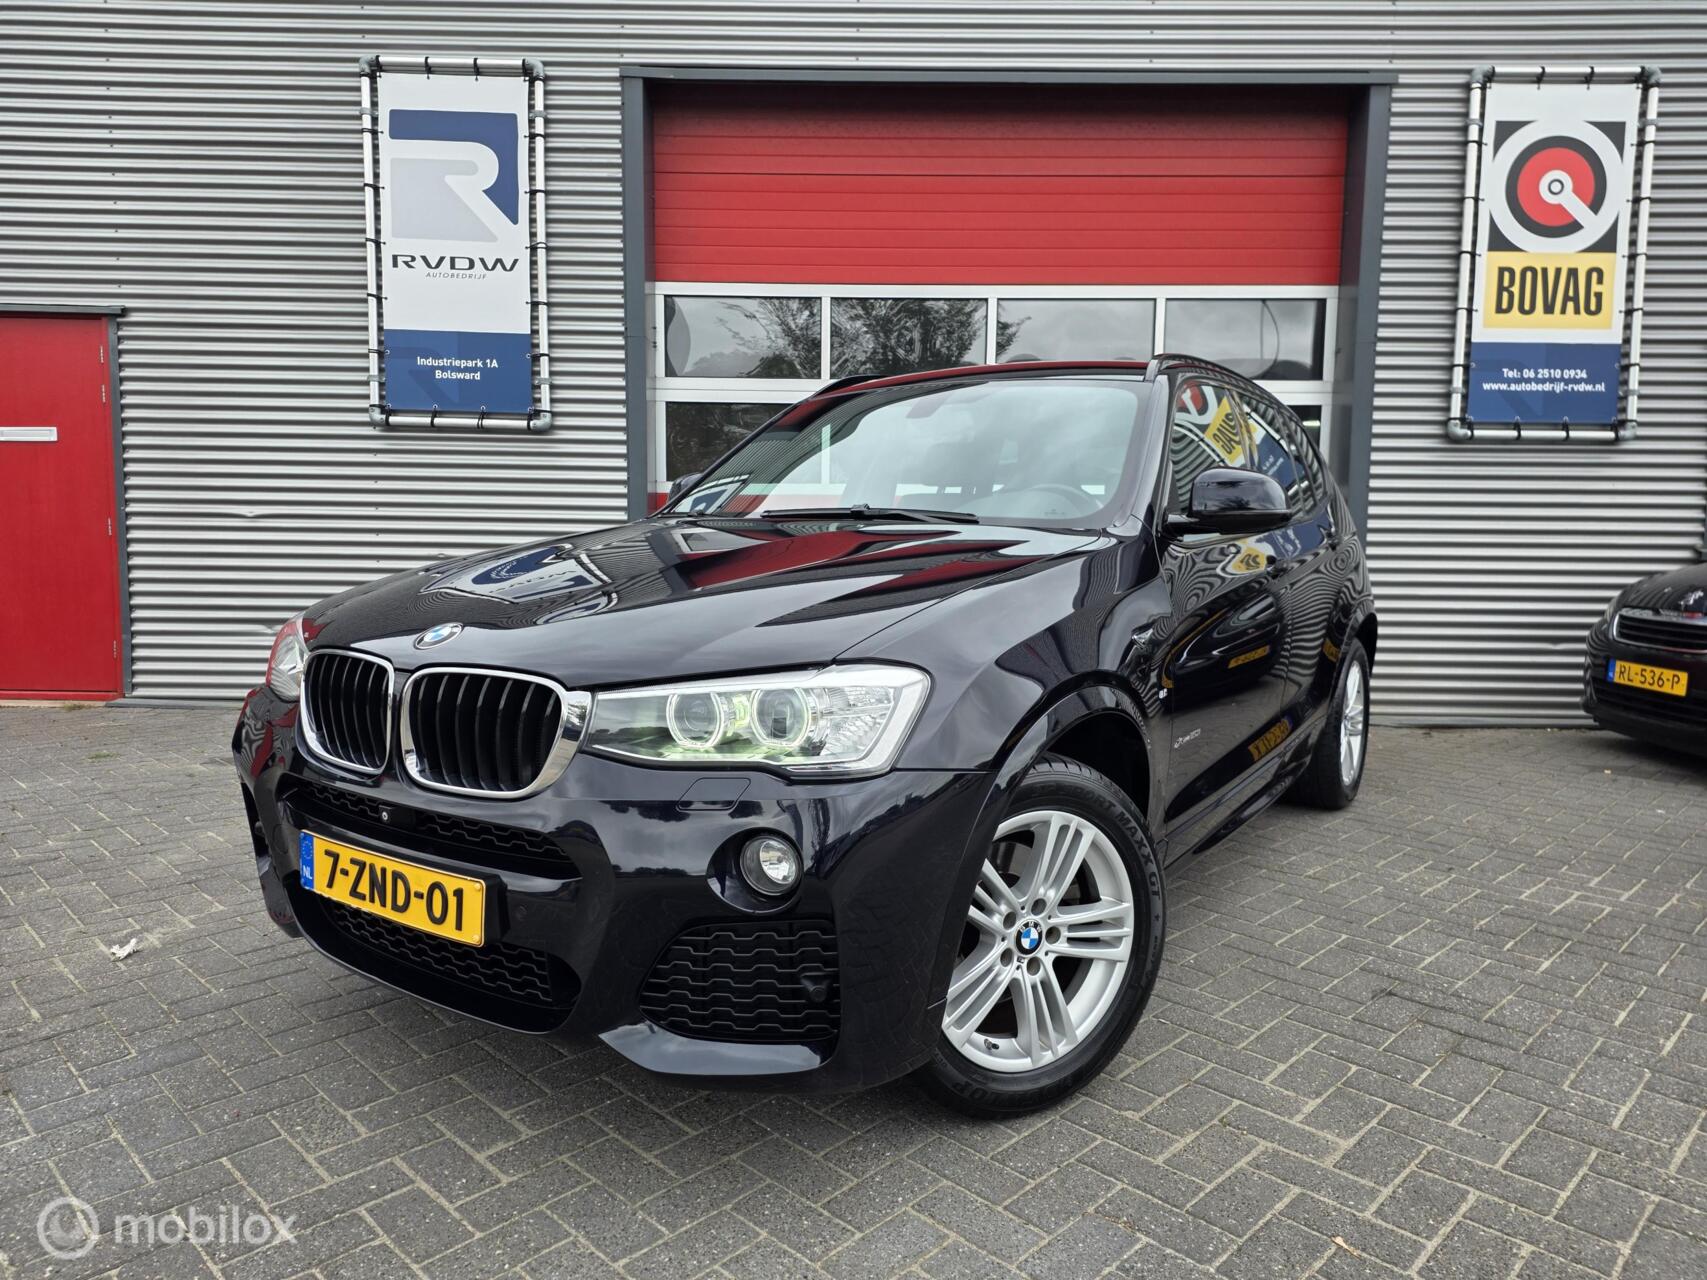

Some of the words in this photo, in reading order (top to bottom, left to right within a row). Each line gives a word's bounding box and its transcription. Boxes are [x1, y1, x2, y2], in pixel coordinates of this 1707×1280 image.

[391, 254, 519, 272] RVDW
[425, 271, 487, 280] AUTOBEDRIJF
[1494, 266, 1604, 315] BOVAG
[416, 356, 483, 369] Industriepark
[485, 358, 498, 368] 1A
[435, 369, 480, 380] Bolsward
[1502, 368, 1520, 378] Tel:
[1523, 368, 1535, 378] 06
[1537, 369, 1561, 379] 2510
[1563, 369, 1588, 379] 0934
[1482, 381, 1605, 393] www.autobedrijf-rvdw.nl
[1618, 663, 1681, 690] RL-536-P
[1115, 811, 1154, 866] MAXX
[1149, 871, 1161, 897] GT
[303, 864, 313, 880] NL
[324, 849, 464, 931] 7-ZND-01
